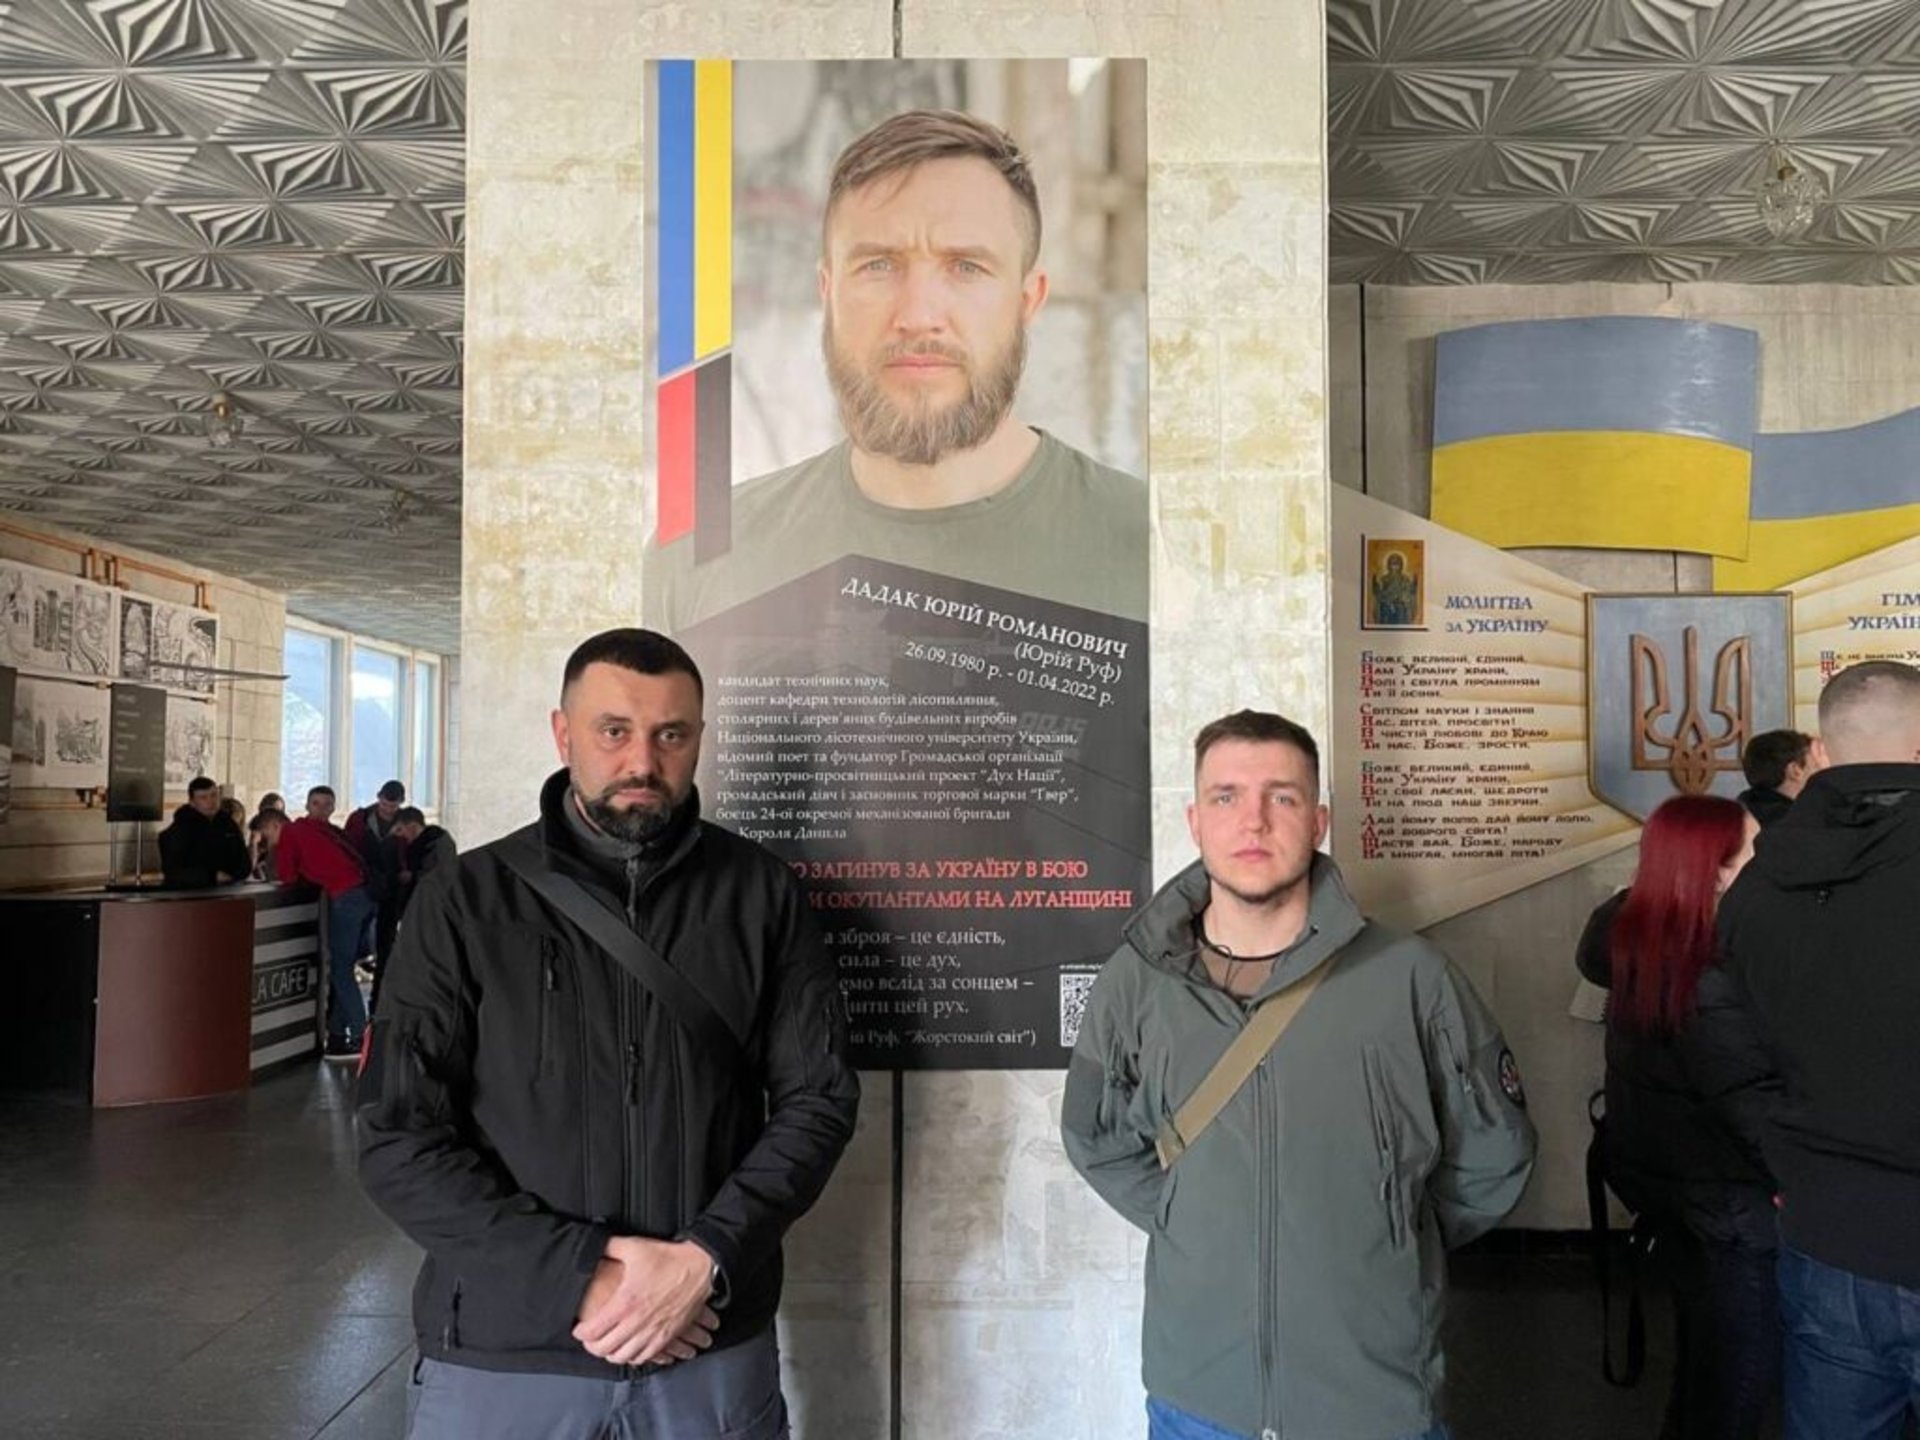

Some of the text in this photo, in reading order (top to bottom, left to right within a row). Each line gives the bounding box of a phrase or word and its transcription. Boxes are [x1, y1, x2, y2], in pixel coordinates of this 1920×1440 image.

[1445, 595, 1533, 610] МОЛИТВА
[841, 576, 1128, 659] ДАДАК ЮРІЙ РОМАНОВИЧ
[1466, 617, 1548, 634] УКРАЇНУ
[1014, 641, 1122, 684] (Юрій Руф)
[717, 675, 890, 690] кандидат технічних наук,
[904, 642, 985, 672] 26.09.1980
[987, 663, 1003, 680] р.
[1017, 669, 1097, 700] 01.04.2022
[1099, 690, 1114, 707] р.
[717, 692, 999, 709] доцент кафедри технологій лісопиляння,
[717, 714, 790, 728] столярних
[878, 711, 960, 728] будівельних
[964, 711, 1017, 728] виробів
[717, 730, 1078, 747] Національного лісотехнічного університету України,
[717, 750, 1063, 766] відомий поет та фундатор Громадської організації
[980, 768, 1014, 785] "Дух
[717, 789, 805, 804] громадський
[809, 790, 837, 802] діяч
[849, 790, 919, 801] засновник
[923, 788, 980, 804] торгової
[983, 790, 1026, 804] марки
[715, 807, 1010, 824] боєць 24-ої окремої механізованої бригади
[738, 826, 846, 843] Короля Данила
[811, 861, 901, 878] ЗАГИНУВ
[905, 861, 931, 878] ЗА
[935, 857, 1021, 878] УКРАЇНУ
[1026, 860, 1038, 878] В
[1041, 860, 1088, 878] БОЮ
[828, 890, 970, 908] ОКУПАНТАМИ
[975, 890, 1006, 908] НА
[1009, 890, 1133, 911] ЛУГАНЩИНІ
[838, 927, 891, 949] зброя
[911, 931, 932, 946] це
[936, 927, 1006, 946] єдність,
[901, 954, 921, 969] це
[926, 954, 961, 972] дух,
[271, 967, 307, 998] CAFE
[879, 973, 924, 992] вслід
[929, 977, 946, 990] за
[952, 977, 1018, 992] сонцем
[894, 998, 928, 1015] цей
[933, 1000, 969, 1019] рух.
